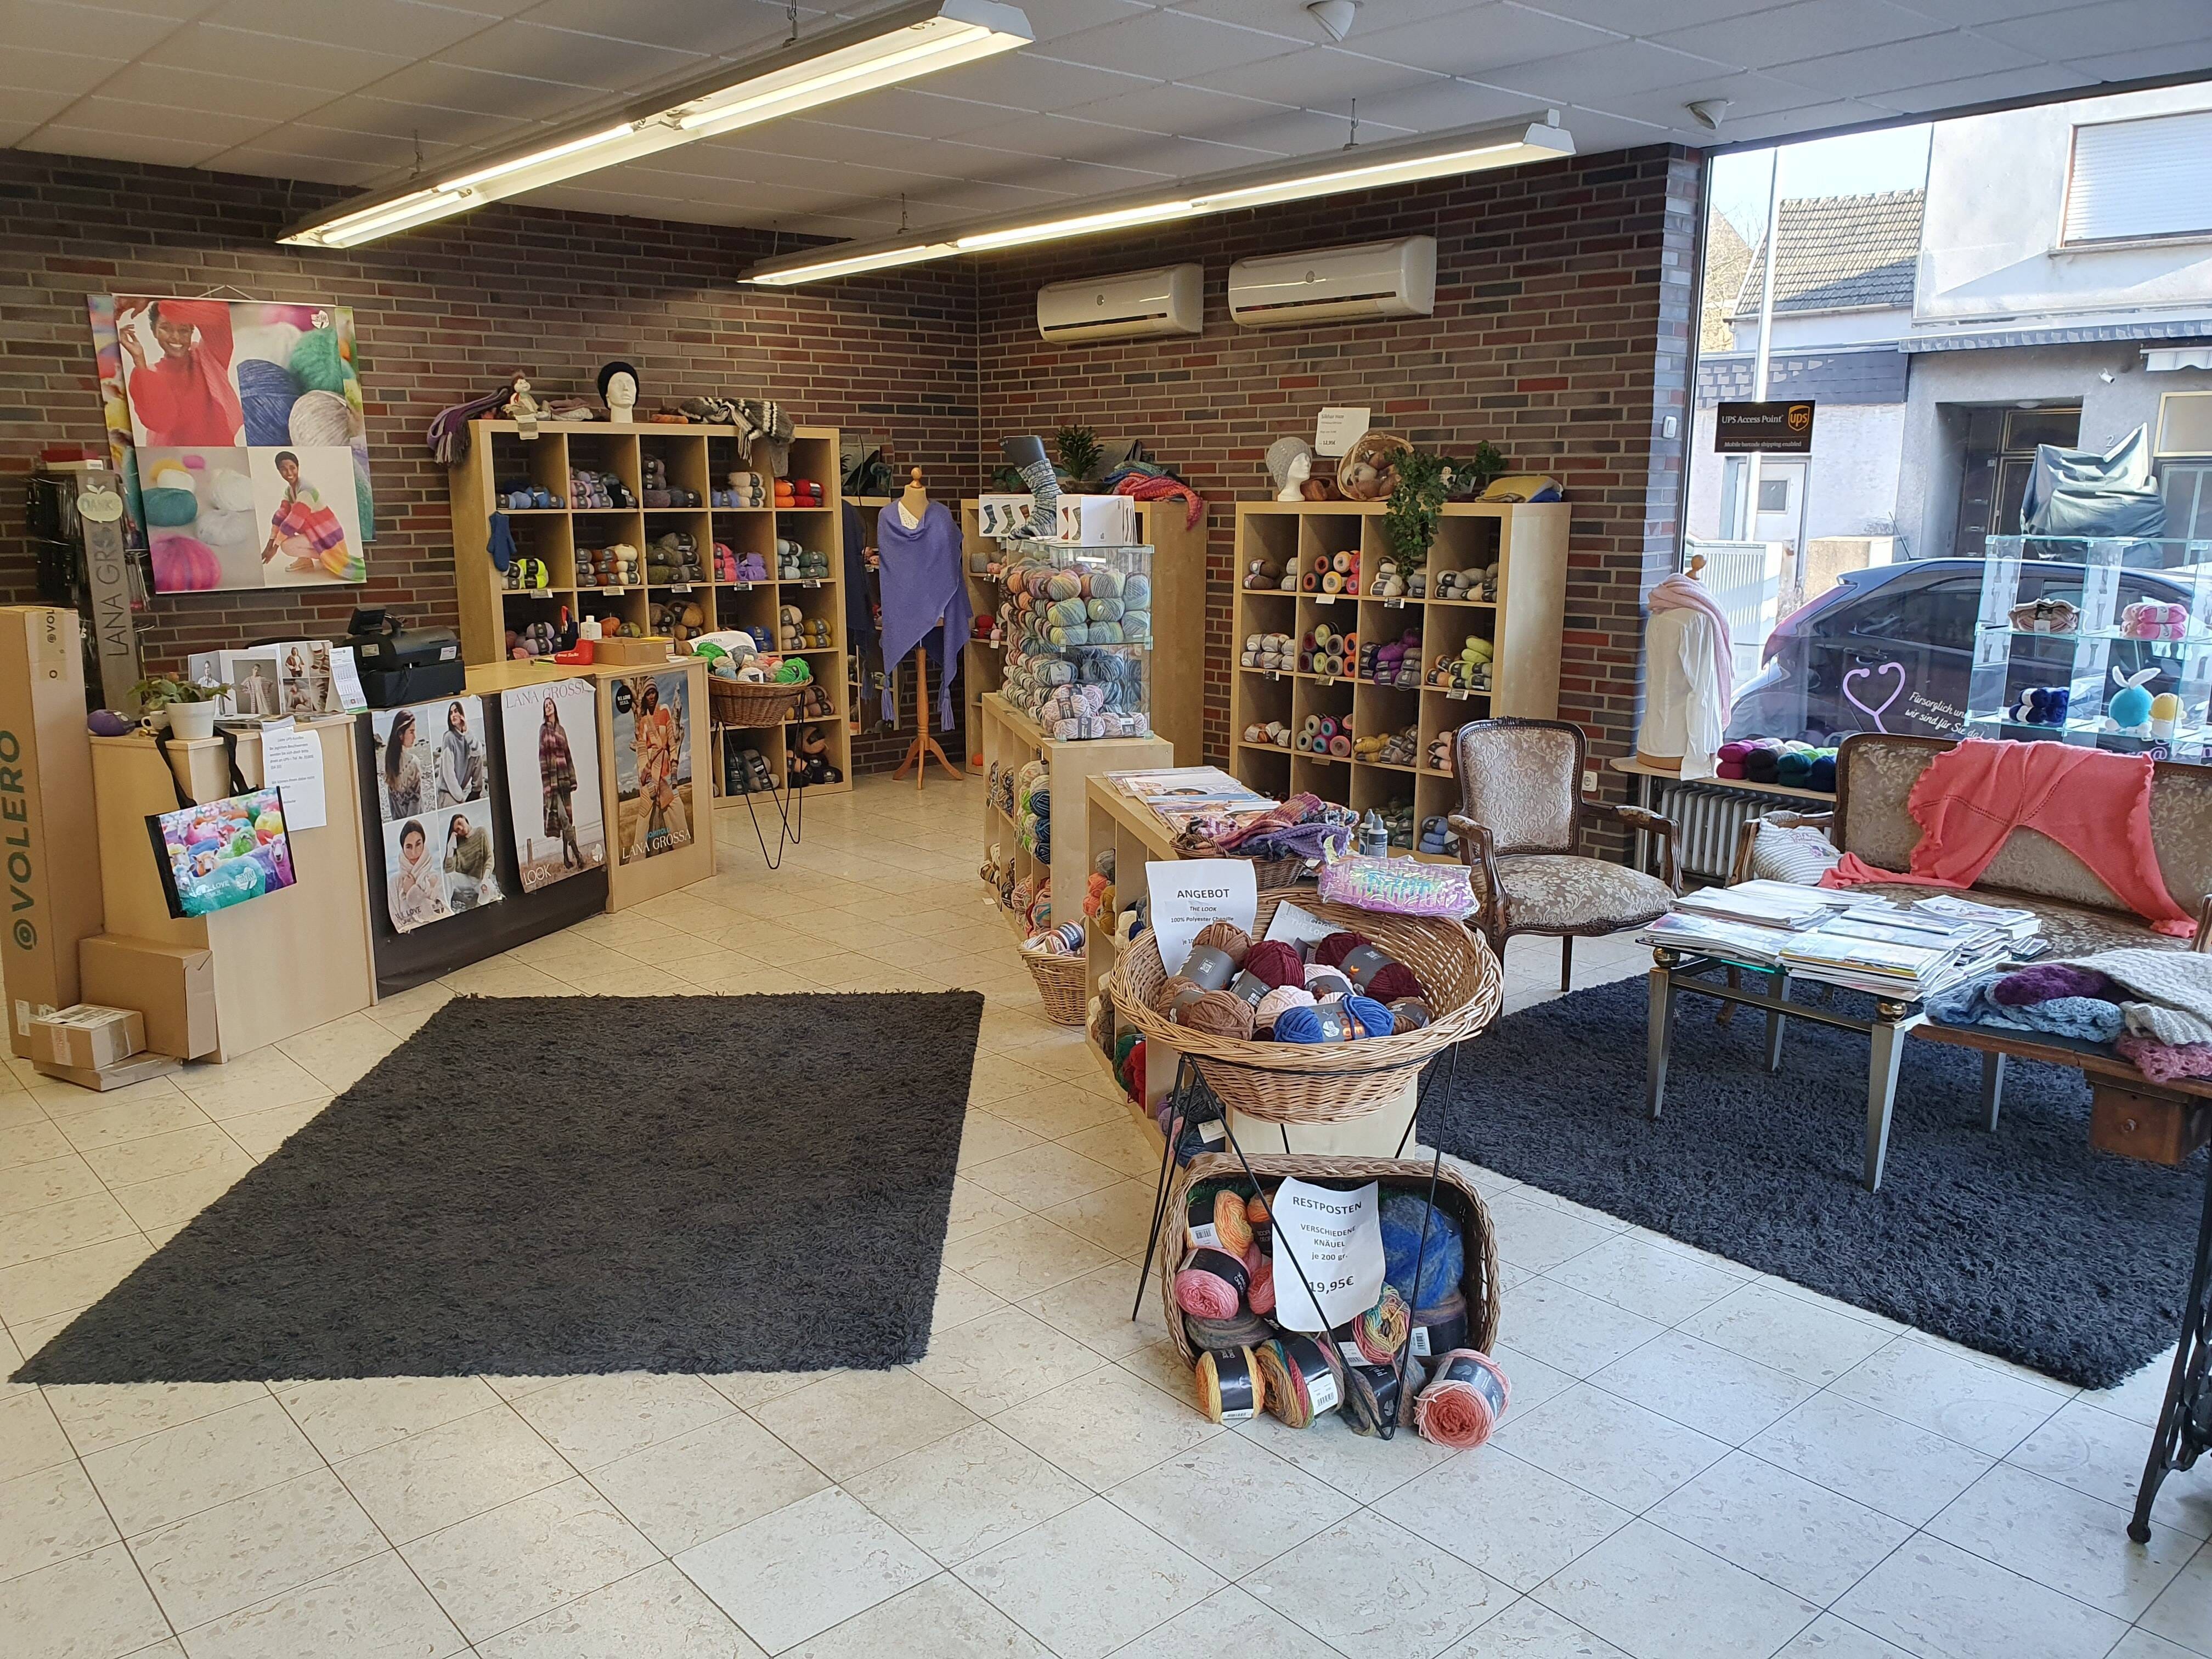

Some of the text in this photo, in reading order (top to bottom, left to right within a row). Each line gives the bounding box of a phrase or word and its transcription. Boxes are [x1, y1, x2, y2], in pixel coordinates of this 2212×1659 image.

[1762, 415, 1782, 423] Point
[1790, 413, 1808, 427] ups
[100, 593, 129, 656] LANA
[506, 691, 539, 708] LANA
[1909, 692, 1966, 719] Fürsorglich un
[1905, 709, 1920, 718] wir
[1919, 713, 1937, 725] sind
[1935, 718, 1951, 730] für
[1951, 723, 1967, 735] Sie
[622, 829, 691, 860] LANA GROSSA
[523, 864, 552, 885] LOOK
[212, 880, 230, 890] LOVE
[1177, 889, 1229, 898] ANGEBOT
[406, 906, 422, 916] LOVE
[1308, 926, 1327, 938] LOO
[1293, 1197, 1362, 1215] RESTPOSTEN
[1300, 1223, 1356, 1237] VERSCHIEDENE
[1314, 1239, 1345, 1248] KNÄUEL
[1312, 1252, 1319, 1260] je
[1309, 1276, 1354, 1294] 19,95€
